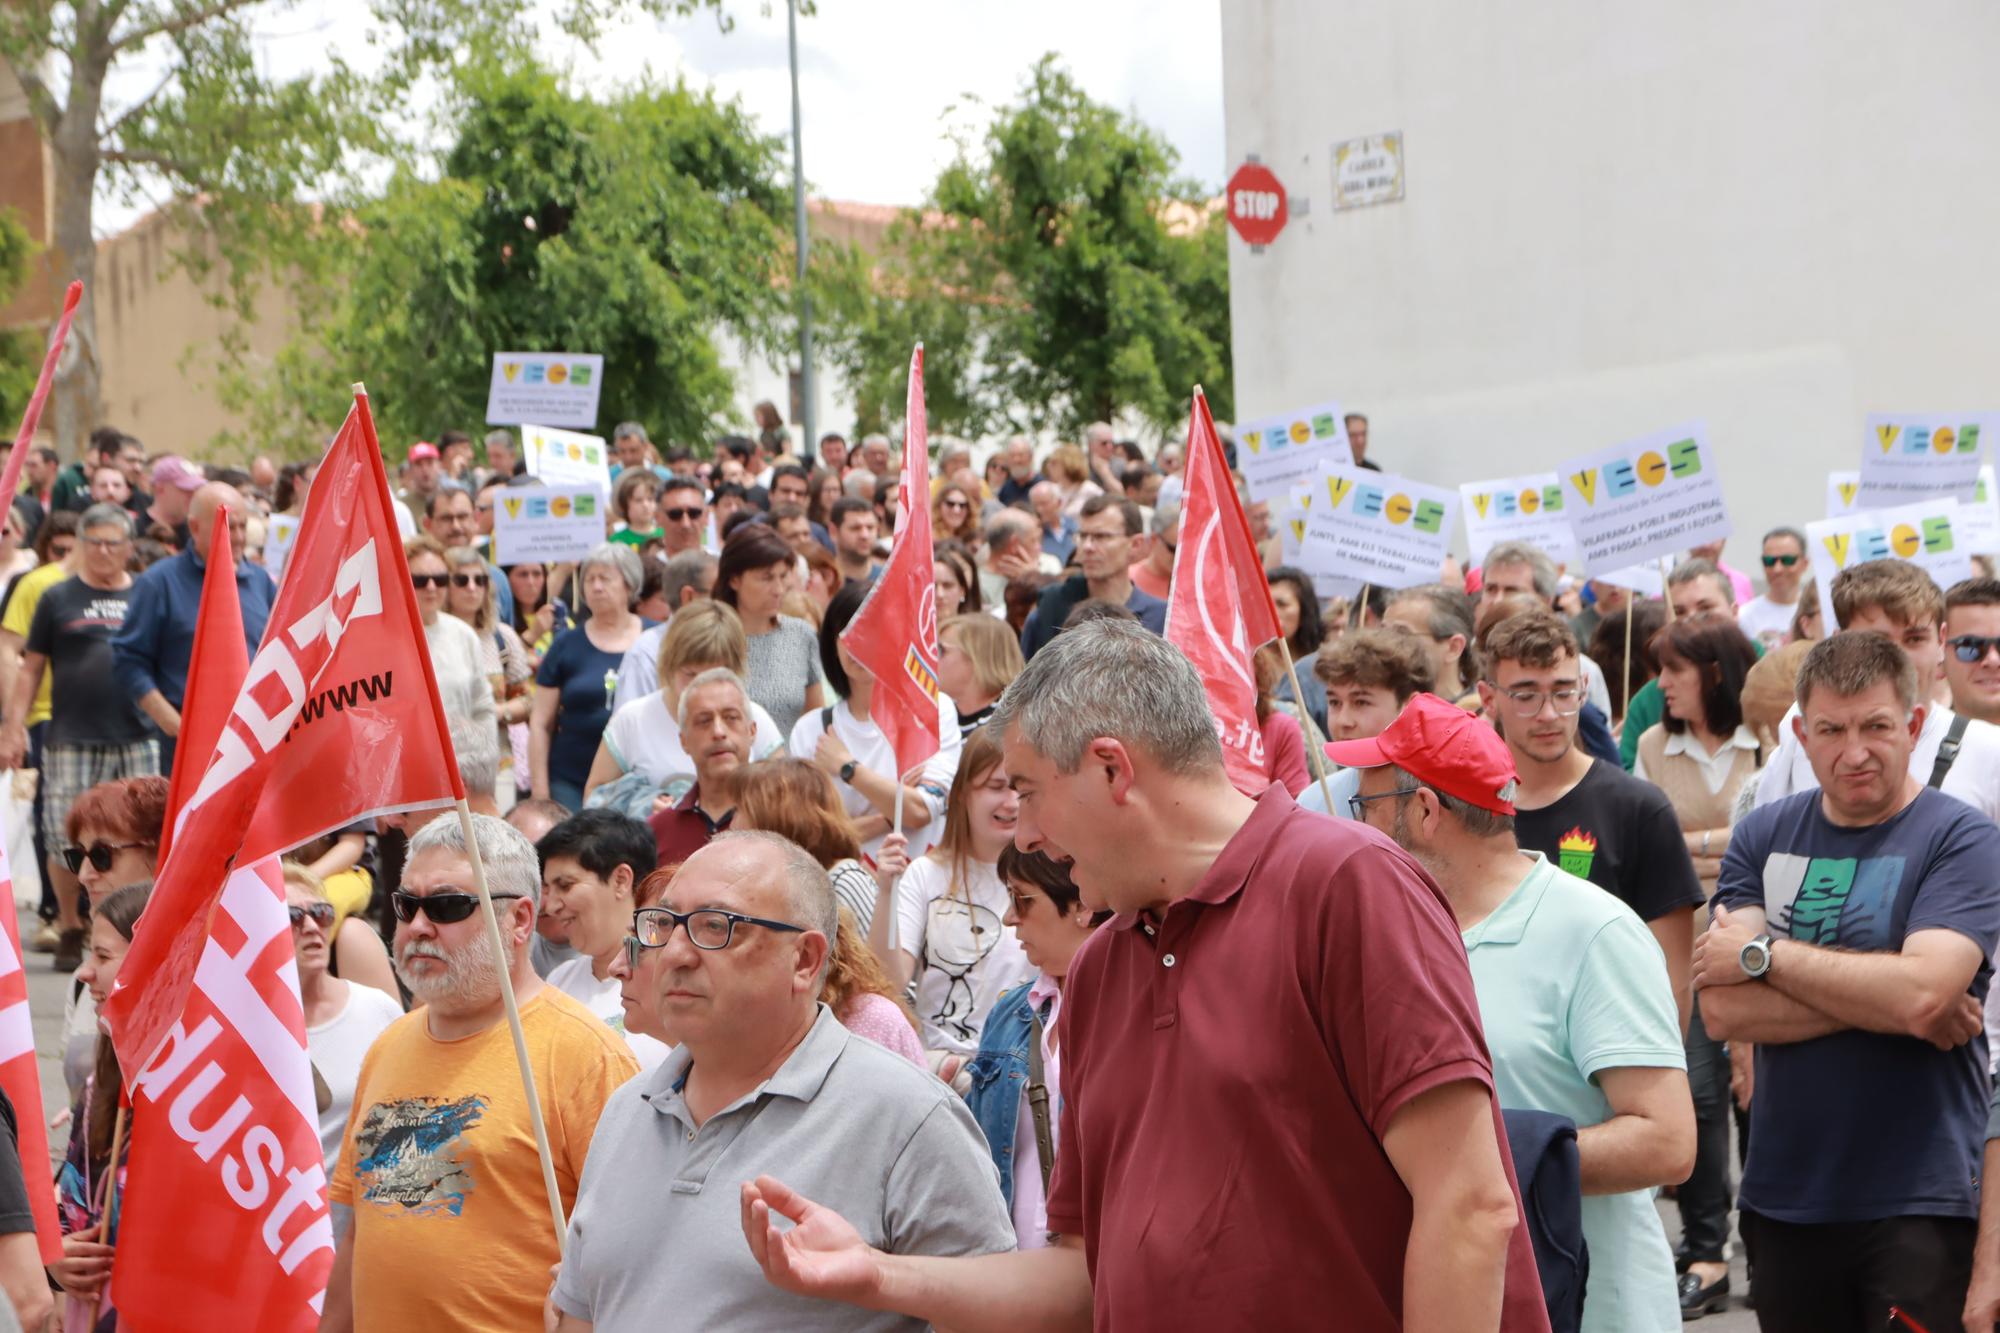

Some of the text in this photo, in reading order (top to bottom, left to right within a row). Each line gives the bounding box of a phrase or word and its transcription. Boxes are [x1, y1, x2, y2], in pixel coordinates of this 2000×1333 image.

[1234, 190, 1279, 220] STOP
[1582, 498, 1723, 547] VILAFRANCA POBLE INDUSTRIAL
[1588, 547, 1608, 561] AMB
[1611, 537, 1647, 554] PASSAT,
[1647, 523, 1686, 543] PRESENT
[1693, 512, 1724, 529] FUTUR
[1336, 550, 1406, 573] DE MARIE CLAIRE
[1340, 536, 1360, 547] AMB
[1361, 541, 1375, 552] ELS
[1378, 545, 1440, 568] TREBALLADORS
